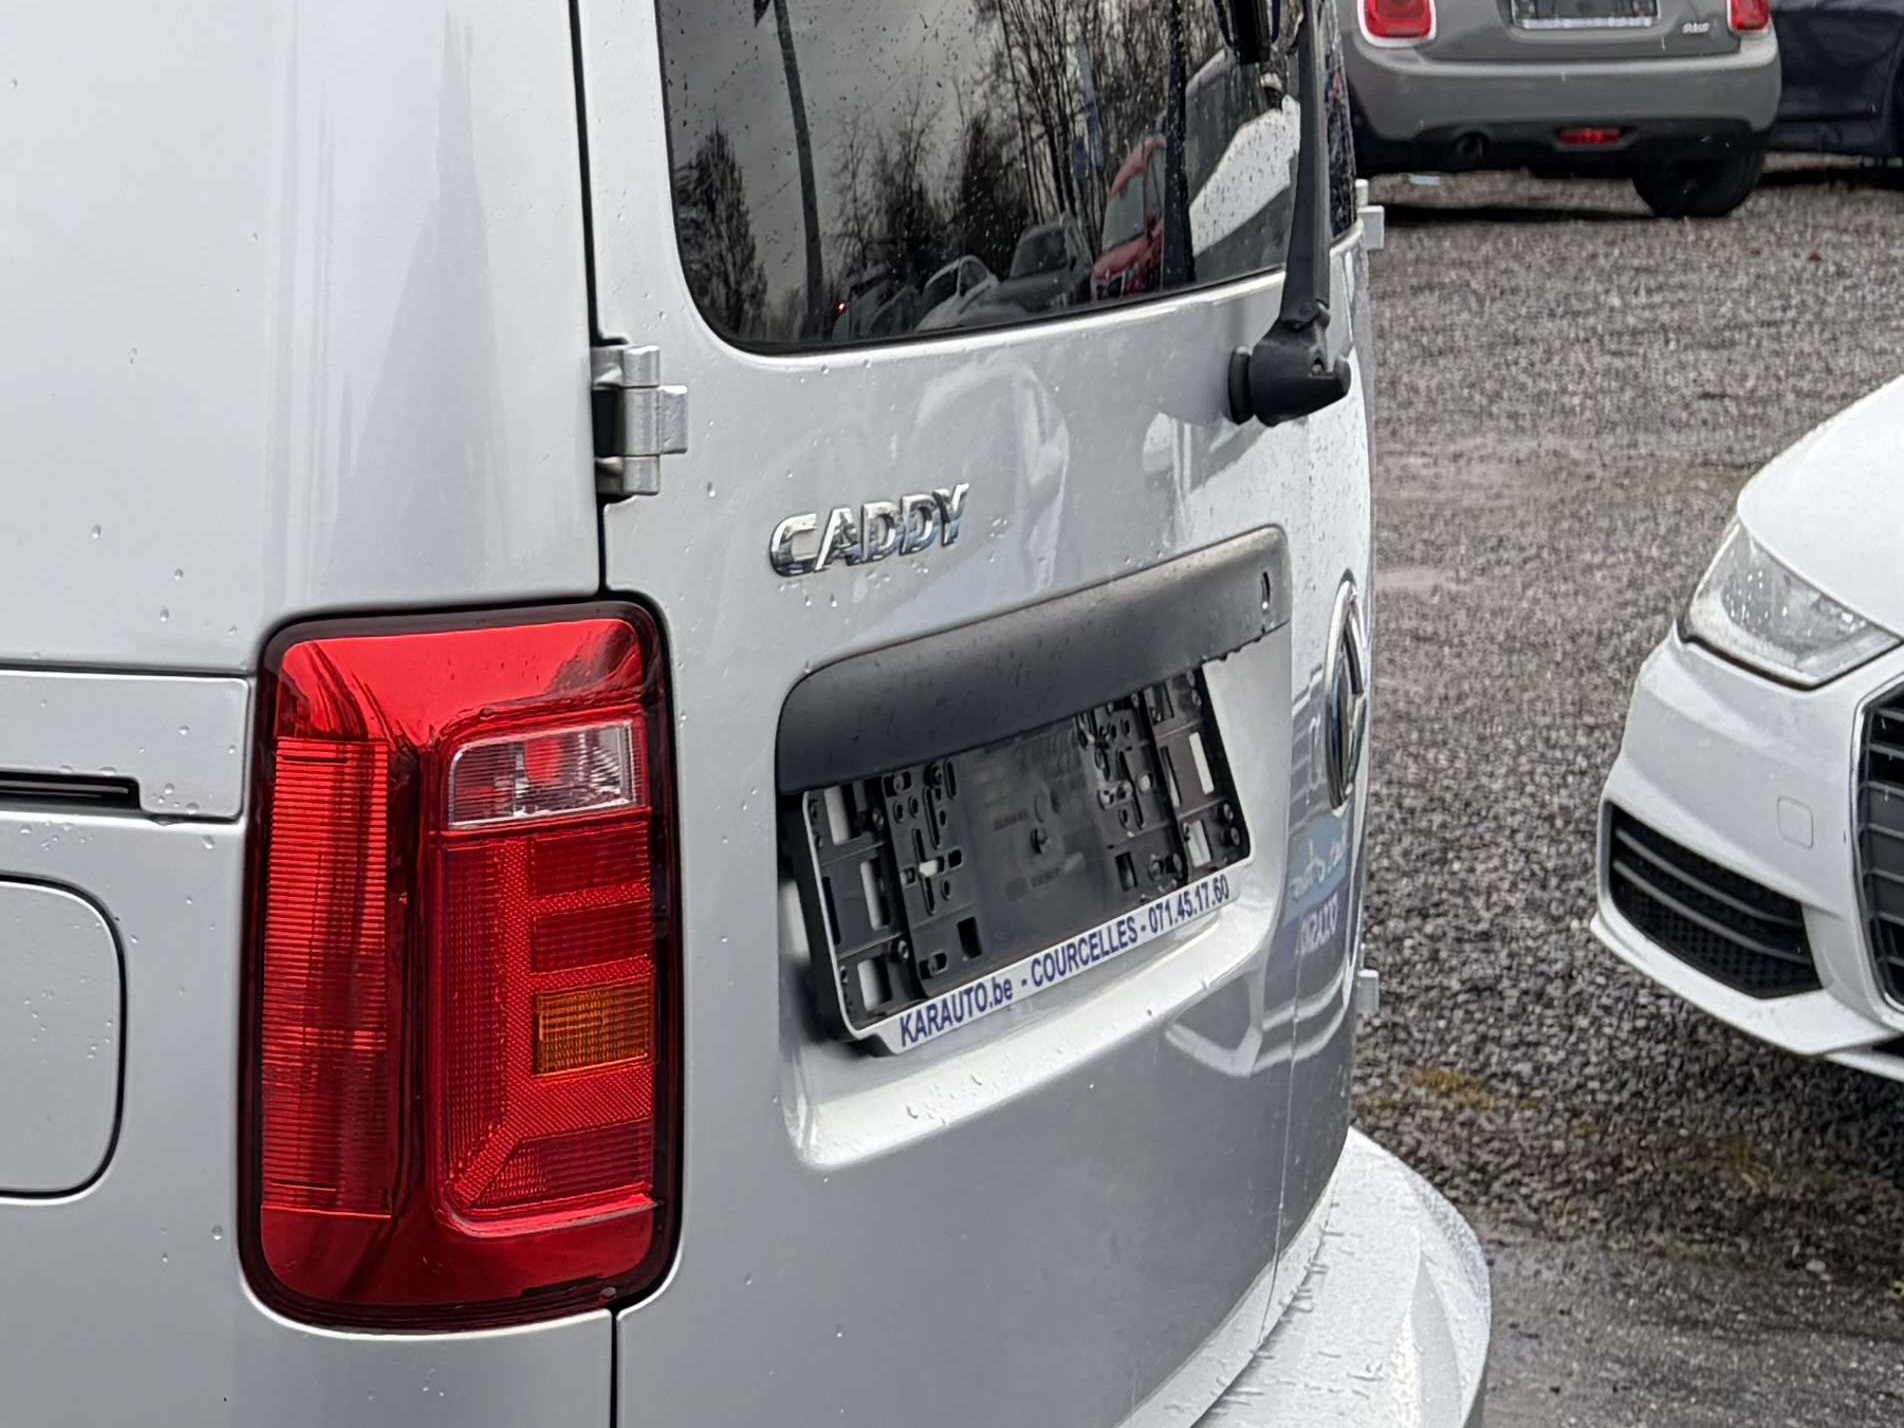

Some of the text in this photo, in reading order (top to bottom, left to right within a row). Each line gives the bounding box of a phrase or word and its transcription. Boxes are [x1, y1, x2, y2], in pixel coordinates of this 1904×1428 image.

[769, 483, 970, 577] CADDY
[899, 976, 1014, 1047] KARAUTO.be
[1030, 916, 1139, 987] COURCELLES
